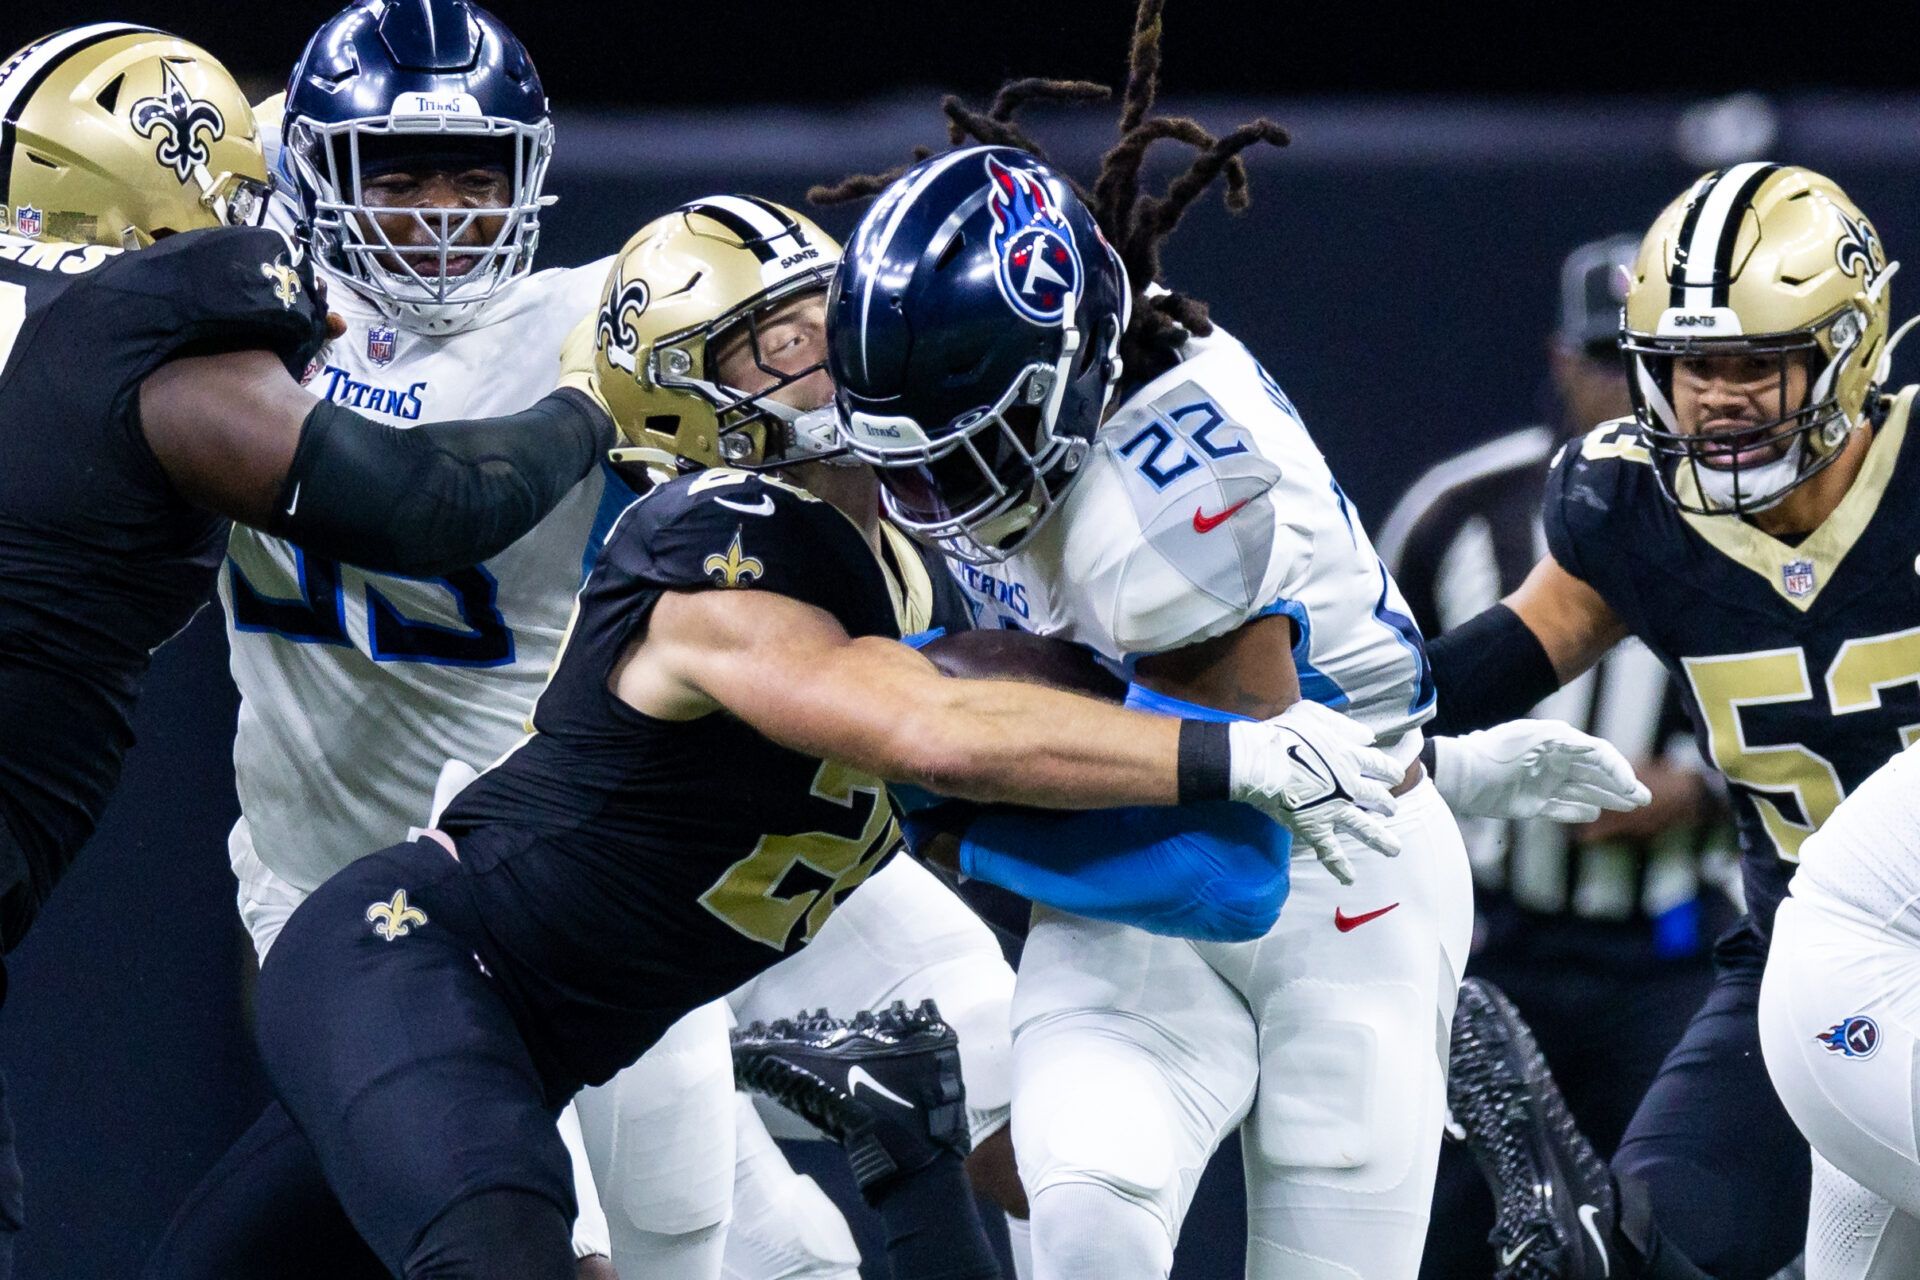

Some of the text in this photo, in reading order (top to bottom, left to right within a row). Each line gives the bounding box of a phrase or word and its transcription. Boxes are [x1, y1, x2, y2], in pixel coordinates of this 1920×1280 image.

[416, 97, 460, 112] TITANS
[20, 219, 40, 233] NFL
[781, 249, 819, 269] SAINTS
[1674, 316, 1716, 327] SAINTS
[323, 365, 427, 420] TITANS
[863, 421, 900, 438] TITANS
